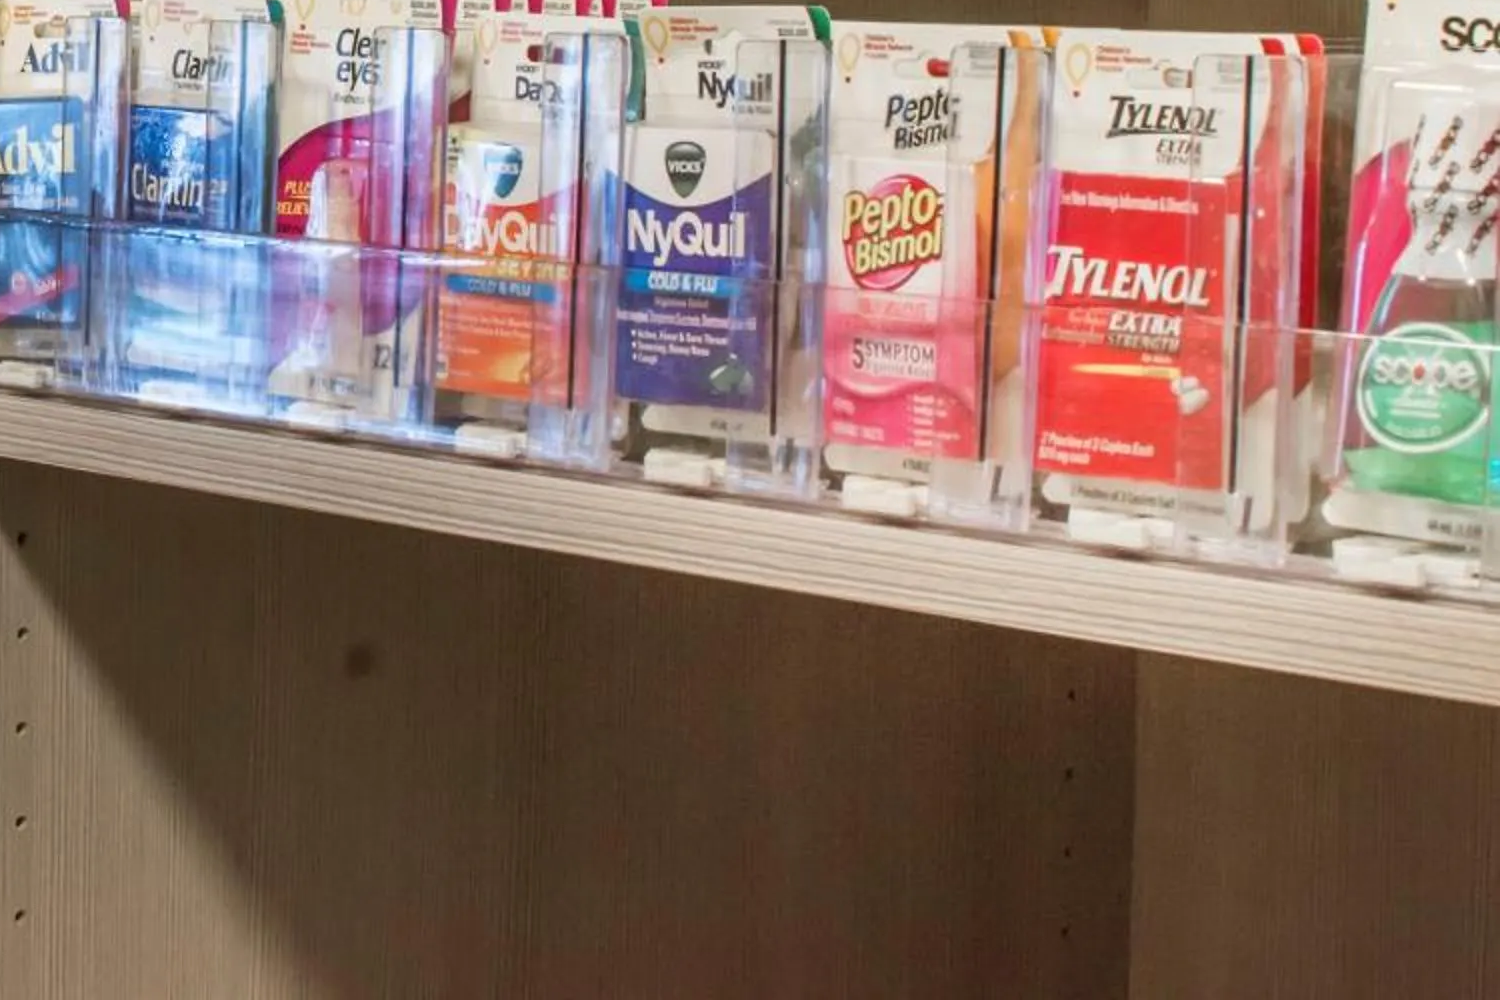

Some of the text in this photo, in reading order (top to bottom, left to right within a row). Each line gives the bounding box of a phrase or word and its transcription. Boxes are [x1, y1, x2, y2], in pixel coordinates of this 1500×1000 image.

[337, 28, 388, 59] Cler
[1440, 16, 1500, 53] SC
[20, 43, 90, 74] Advil
[171, 48, 234, 81] Clarin
[1105, 95, 1218, 139] TYLENOL
[667, 160, 702, 173] VICKS
[132, 162, 205, 210] Claritin
[842, 183, 945, 242] Pepto-
[627, 207, 746, 267] NyQuil
[854, 216, 942, 275] Bismol
[648, 271, 681, 291] COLD
[694, 273, 718, 293] FLU
[1044, 245, 1210, 307] TYLENOL
[1108, 310, 1182, 337] EXTRA
[852, 337, 935, 369] 5 SYMPTOM
[1105, 332, 1181, 354] STRENGTH
[1373, 353, 1479, 390] scope
